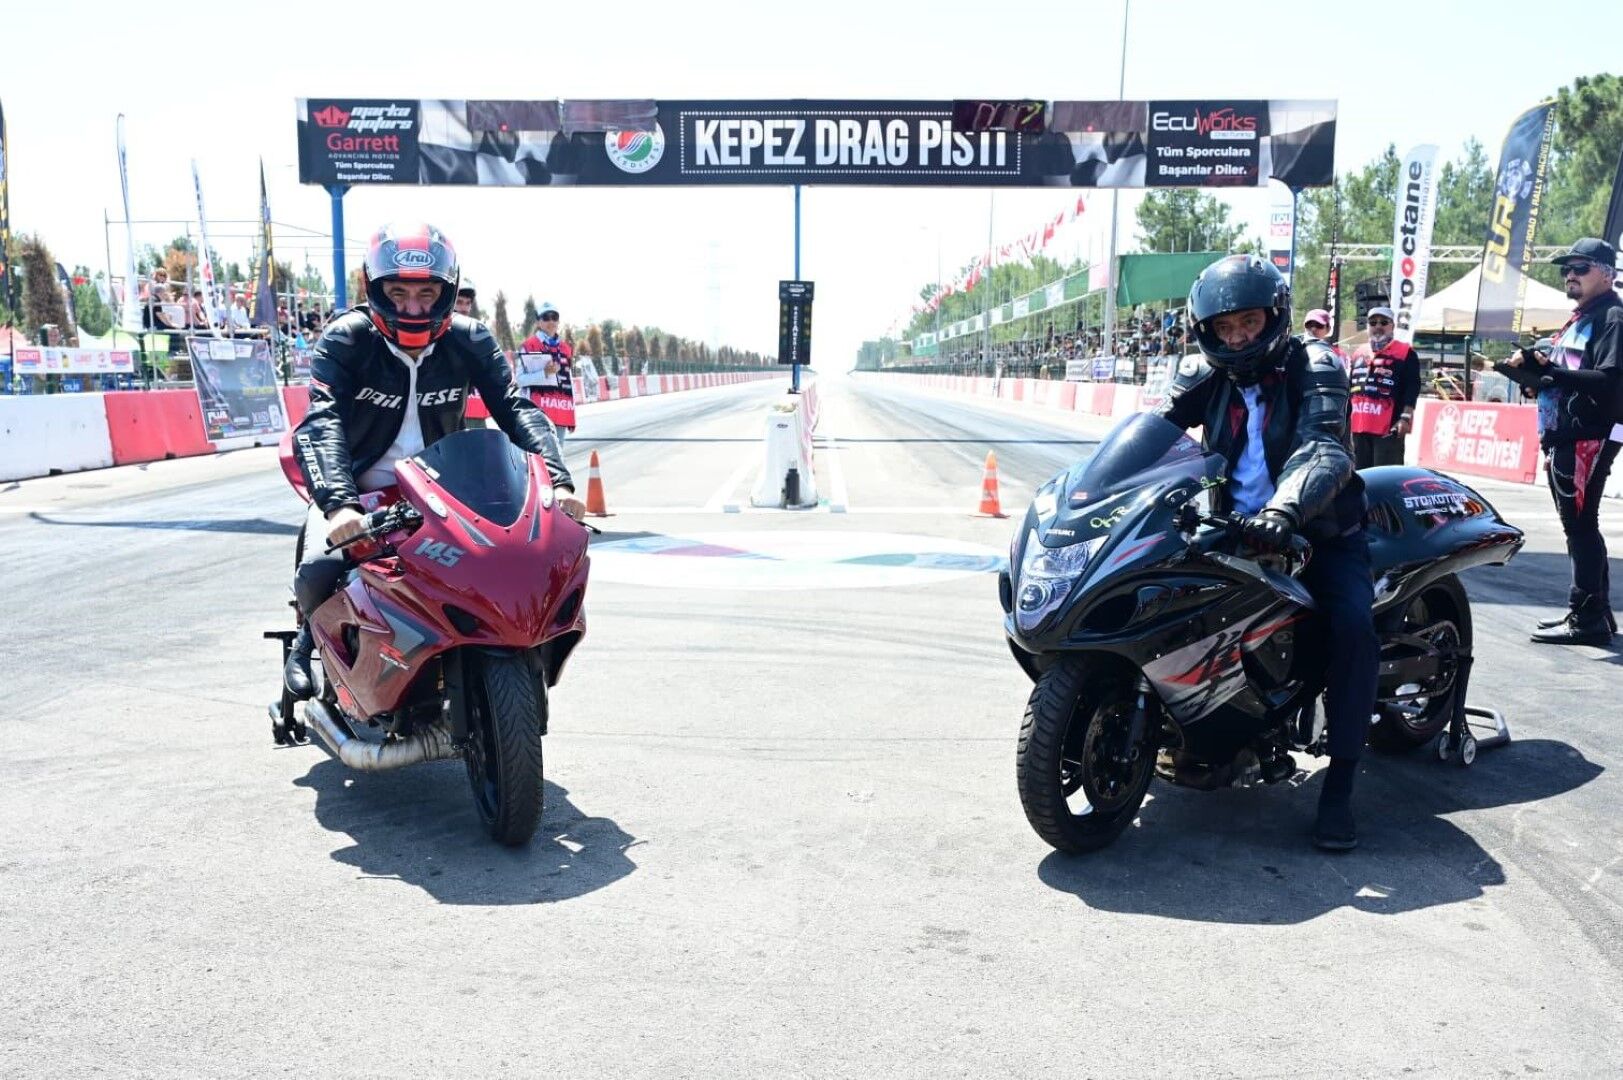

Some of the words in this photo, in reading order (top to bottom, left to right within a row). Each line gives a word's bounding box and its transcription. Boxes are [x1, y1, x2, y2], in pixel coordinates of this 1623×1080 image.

[327, 133, 400, 152] Garrett
[695, 119, 806, 166] KEPEZ
[815, 119, 910, 166] DRAG
[1156, 147, 1184, 157] Tüm
[1186, 146, 1251, 159] Sporculara
[335, 162, 353, 170] Tüm
[354, 162, 395, 171] Sporculara
[1159, 164, 1213, 177] Başarılar
[1215, 163, 1247, 175] Diler.
[1532, 177, 1543, 207] RALLY
[1529, 206, 1539, 216] &
[1397, 160, 1422, 331] prooctane
[1482, 194, 1516, 284] GUR
[399, 251, 430, 263] Arai
[1521, 262, 1529, 272] &
[1512, 308, 1522, 333] DRAG
[1460, 410, 1498, 435] KEPEZ
[1456, 434, 1524, 470] BELEDİYESİ
[414, 537, 467, 568] 145
